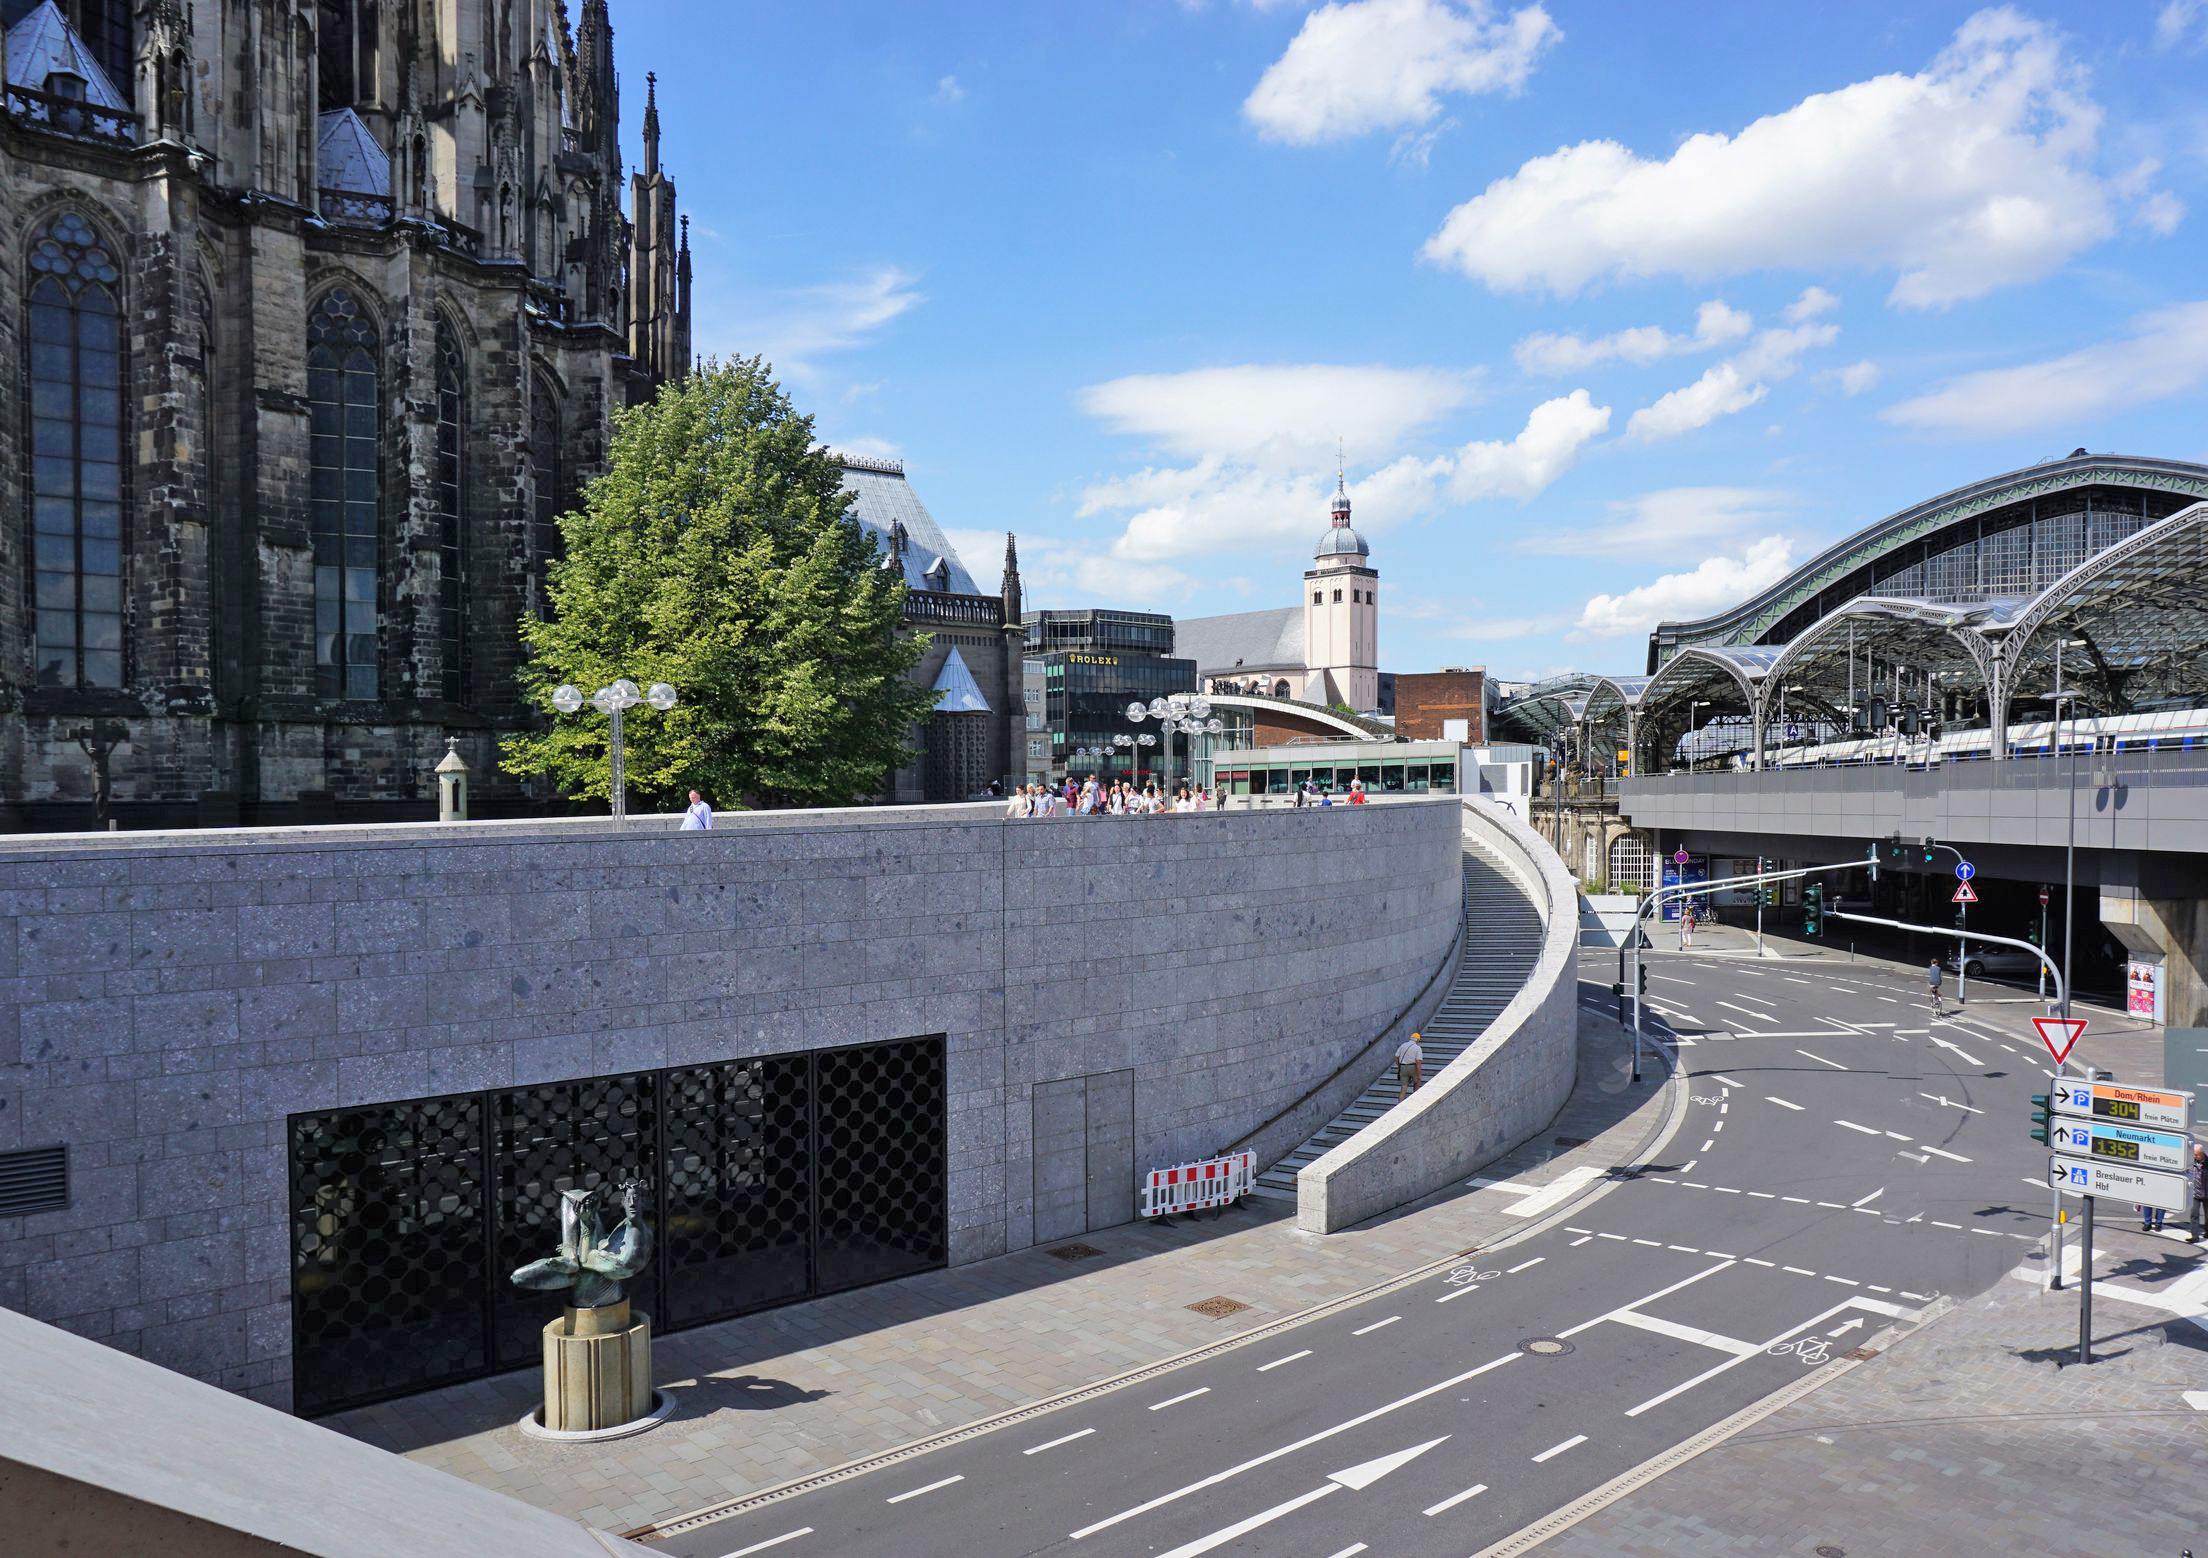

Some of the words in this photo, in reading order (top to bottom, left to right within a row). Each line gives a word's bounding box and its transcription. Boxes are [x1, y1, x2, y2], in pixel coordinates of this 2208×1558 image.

[1077, 655, 1112, 665] ROLEX
[1790, 725, 1798, 735] A
[2114, 1089, 2161, 1104] Dom/Rhein
[2109, 1101, 2139, 1119] 304
[2144, 1112, 2159, 1121] freie
[2160, 1115, 2179, 1124] Plätze
[2115, 1129, 2156, 1144] Neumarkt
[2097, 1139, 2137, 1159] 1352
[2143, 1153, 2158, 1162] freie
[2159, 1155, 2179, 1165] Plätze
[2095, 1169, 2133, 1184] Breslauer
[2135, 1176, 2146, 1186] Pl.
[2095, 1181, 2109, 1192] Hbf
